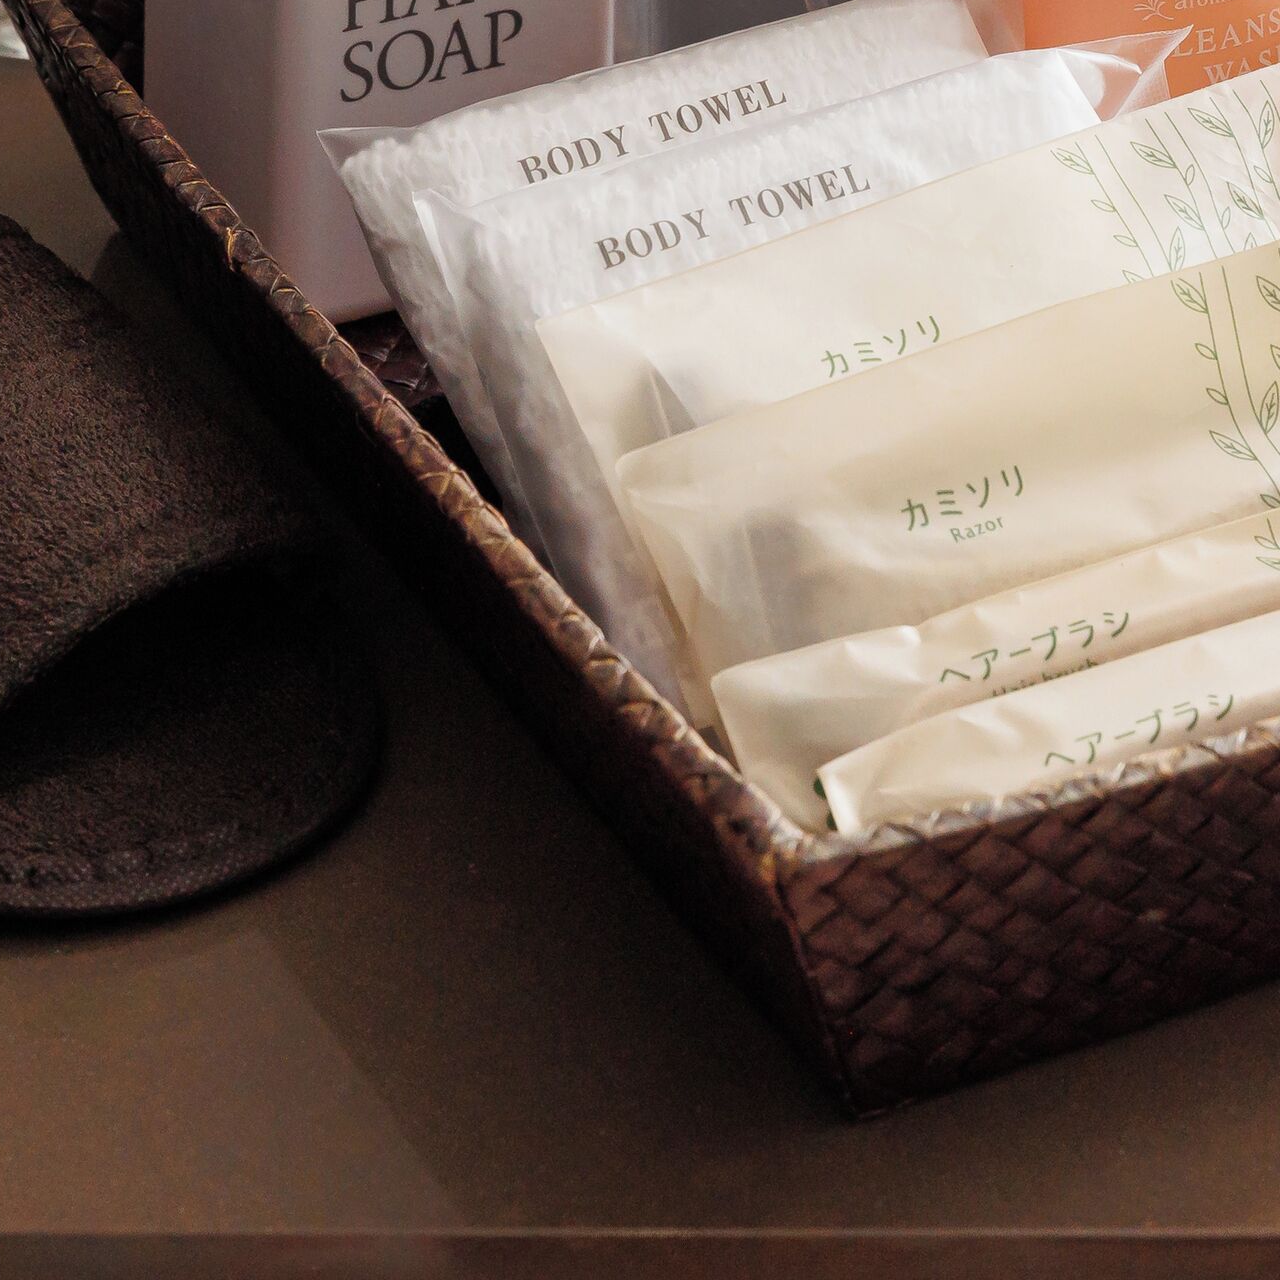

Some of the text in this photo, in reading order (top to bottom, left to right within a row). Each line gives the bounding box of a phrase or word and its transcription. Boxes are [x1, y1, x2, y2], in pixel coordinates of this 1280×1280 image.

[340, 9, 523, 103] SOAP
[517, 78, 787, 185] BODY TOWEL
[594, 164, 872, 269] BODY TOWEL
[821, 315, 941, 377] カミソリ
[901, 465, 1024, 531] カミソリ
[949, 517, 1004, 544] Razor
[940, 612, 1130, 682] ヘアーブラシ
[1044, 694, 1233, 767] ヘアーブラシ
